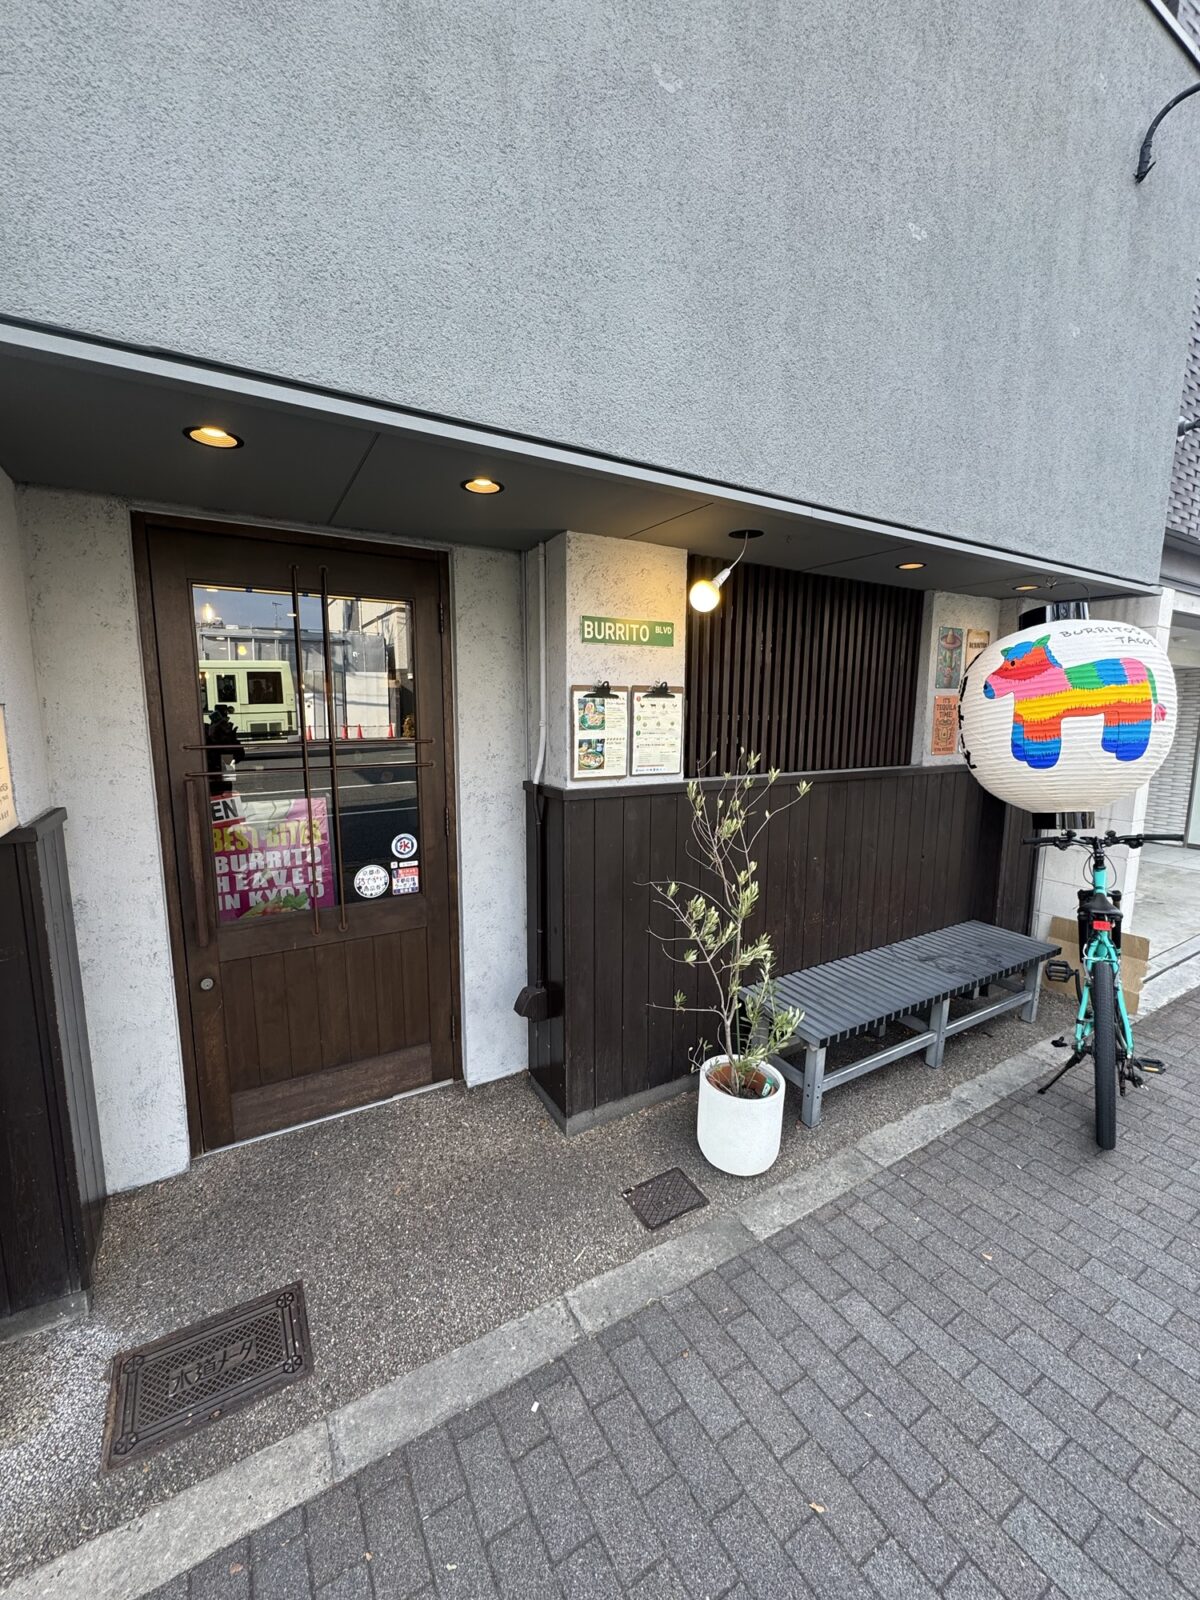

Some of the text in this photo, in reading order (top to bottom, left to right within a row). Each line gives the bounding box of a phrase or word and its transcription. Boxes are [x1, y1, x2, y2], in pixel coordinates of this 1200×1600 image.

[584, 621, 673, 642] BURRITO BLVD
[1059, 627, 1141, 637] BURRITOS
[936, 703, 956, 711] TEQUILA
[212, 825, 259, 853] BEST
[214, 846, 322, 874] BURRITO
[216, 865, 323, 893] HEAVEN
[218, 882, 325, 911] IN KYOTO
[171, 1340, 253, 1394] 水道メータ
